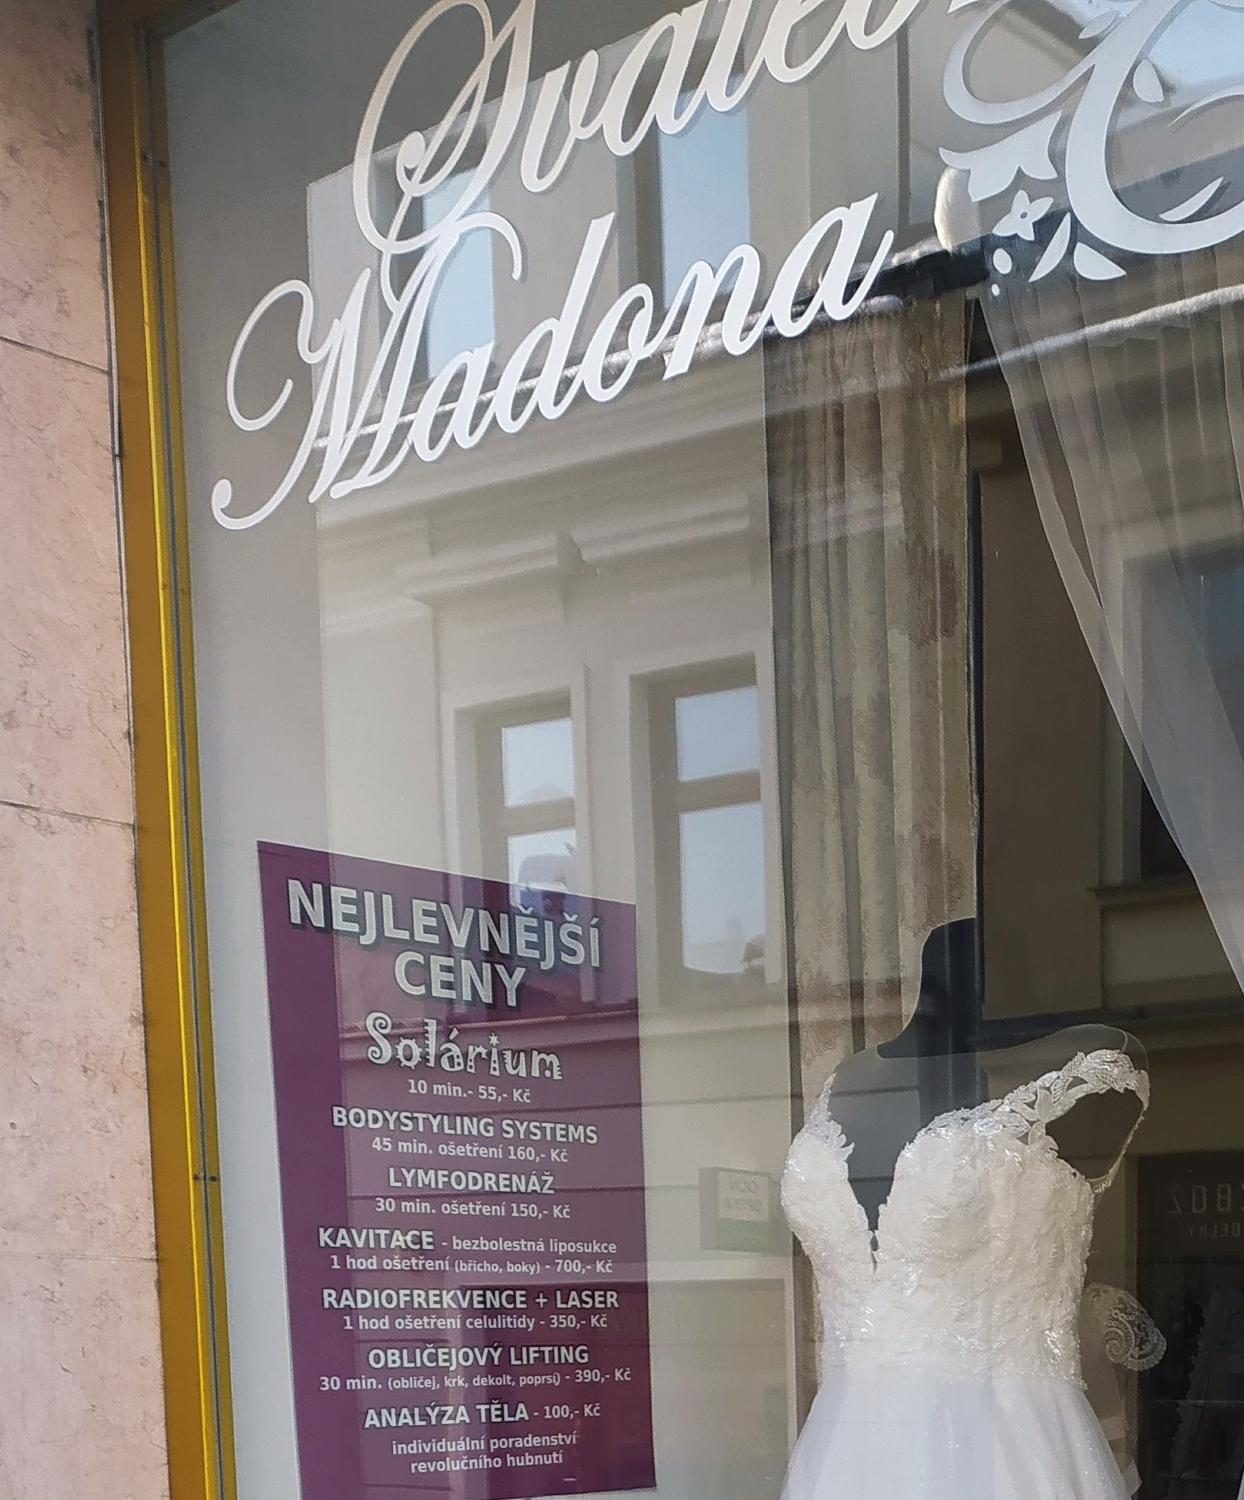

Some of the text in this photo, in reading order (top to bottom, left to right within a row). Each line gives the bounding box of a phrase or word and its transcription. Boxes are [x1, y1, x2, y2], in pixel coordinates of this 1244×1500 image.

[352, 0, 918, 280] Svate
[211, 192, 895, 530] Madona
[287, 877, 600, 971] NEJLEVNĚJŠÍ
[394, 950, 527, 1008] CENY
[365, 1011, 563, 1080] Solárium
[408, 1079, 428, 1094] 10
[478, 1085, 508, 1102] 55,-
[512, 1088, 531, 1103] Kč
[331, 1105, 598, 1145] BODYSTYLING SYSTEMS
[371, 1136, 568, 1163] 45 min. ošetření 160,- Kč
[388, 1167, 555, 1194] LYMFODRENÁŽ
[375, 1197, 571, 1219] 30 min. ošetření 150,- Kč
[318, 1227, 434, 1251] KAVITACE
[452, 1236, 545, 1252] bezbolestná
[549, 1238, 617, 1255] liposukce
[330, 1255, 341, 1269] 1
[346, 1254, 378, 1270] hod
[382, 1254, 450, 1272] ošetření
[506, 1259, 541, 1275] boky)
[555, 1259, 592, 1275] 700,-
[596, 1259, 613, 1273] Kč
[322, 1288, 528, 1310] RADIOFREKVENCE
[556, 1289, 620, 1309] LASER
[342, 1315, 353, 1330] 1
[358, 1314, 390, 1330] hod
[395, 1313, 462, 1330] ošetření
[465, 1312, 535, 1332] celulitidy
[549, 1315, 586, 1330] 350,-
[590, 1313, 608, 1328] Kč
[368, 1342, 590, 1370] OBLIČEJOVÝ LIFTING
[319, 1376, 341, 1391] 30
[346, 1374, 382, 1390] min.
[387, 1375, 440, 1391] (obličej,
[444, 1375, 469, 1388] krk,
[472, 1374, 516, 1387] dekolt,
[574, 1369, 610, 1384] 390,-
[614, 1367, 632, 1381] Kč
[364, 1401, 471, 1429] ANALÝZA
[475, 1399, 530, 1423] TĚLA
[544, 1405, 579, 1420] 100,-
[583, 1402, 601, 1417] Kč
[392, 1429, 578, 1456] individuální poradenství
[410, 1450, 564, 1475] revolučního hubnutí
